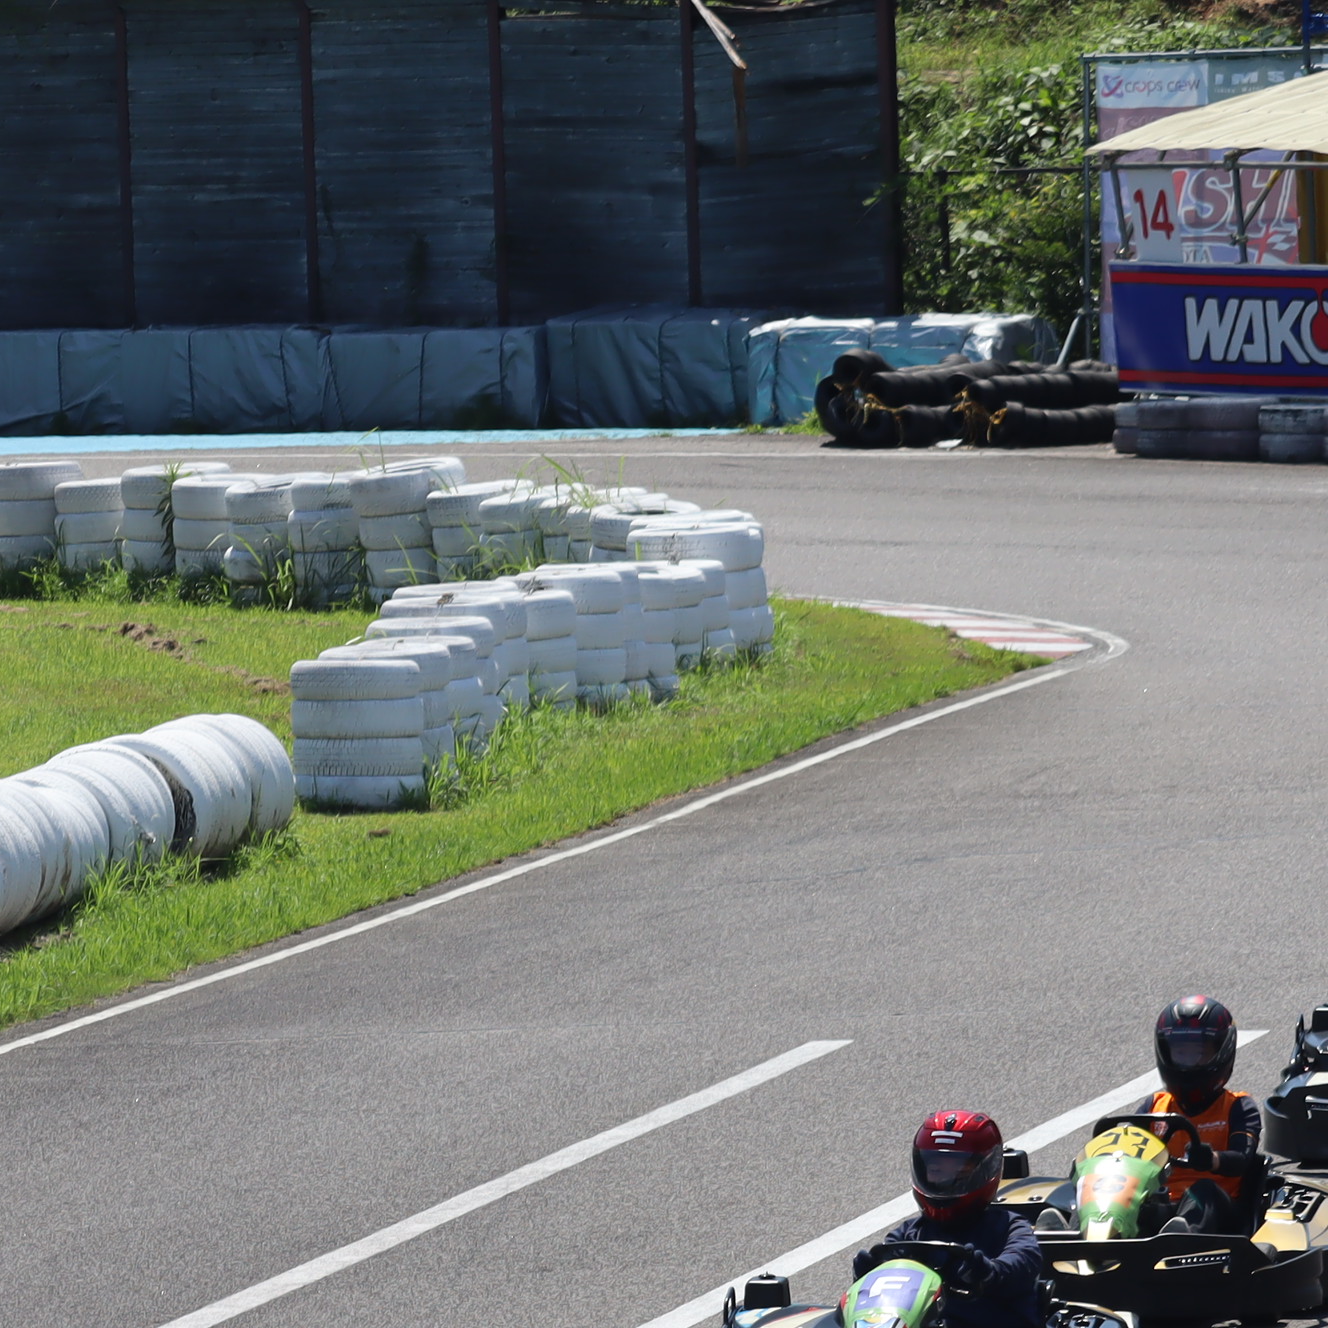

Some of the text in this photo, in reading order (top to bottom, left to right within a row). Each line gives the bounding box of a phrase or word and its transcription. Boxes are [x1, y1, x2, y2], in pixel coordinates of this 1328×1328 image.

[1124, 76, 1201, 96] crops crew
[1133, 188, 1175, 240] 14
[869, 1276, 911, 1298] F
